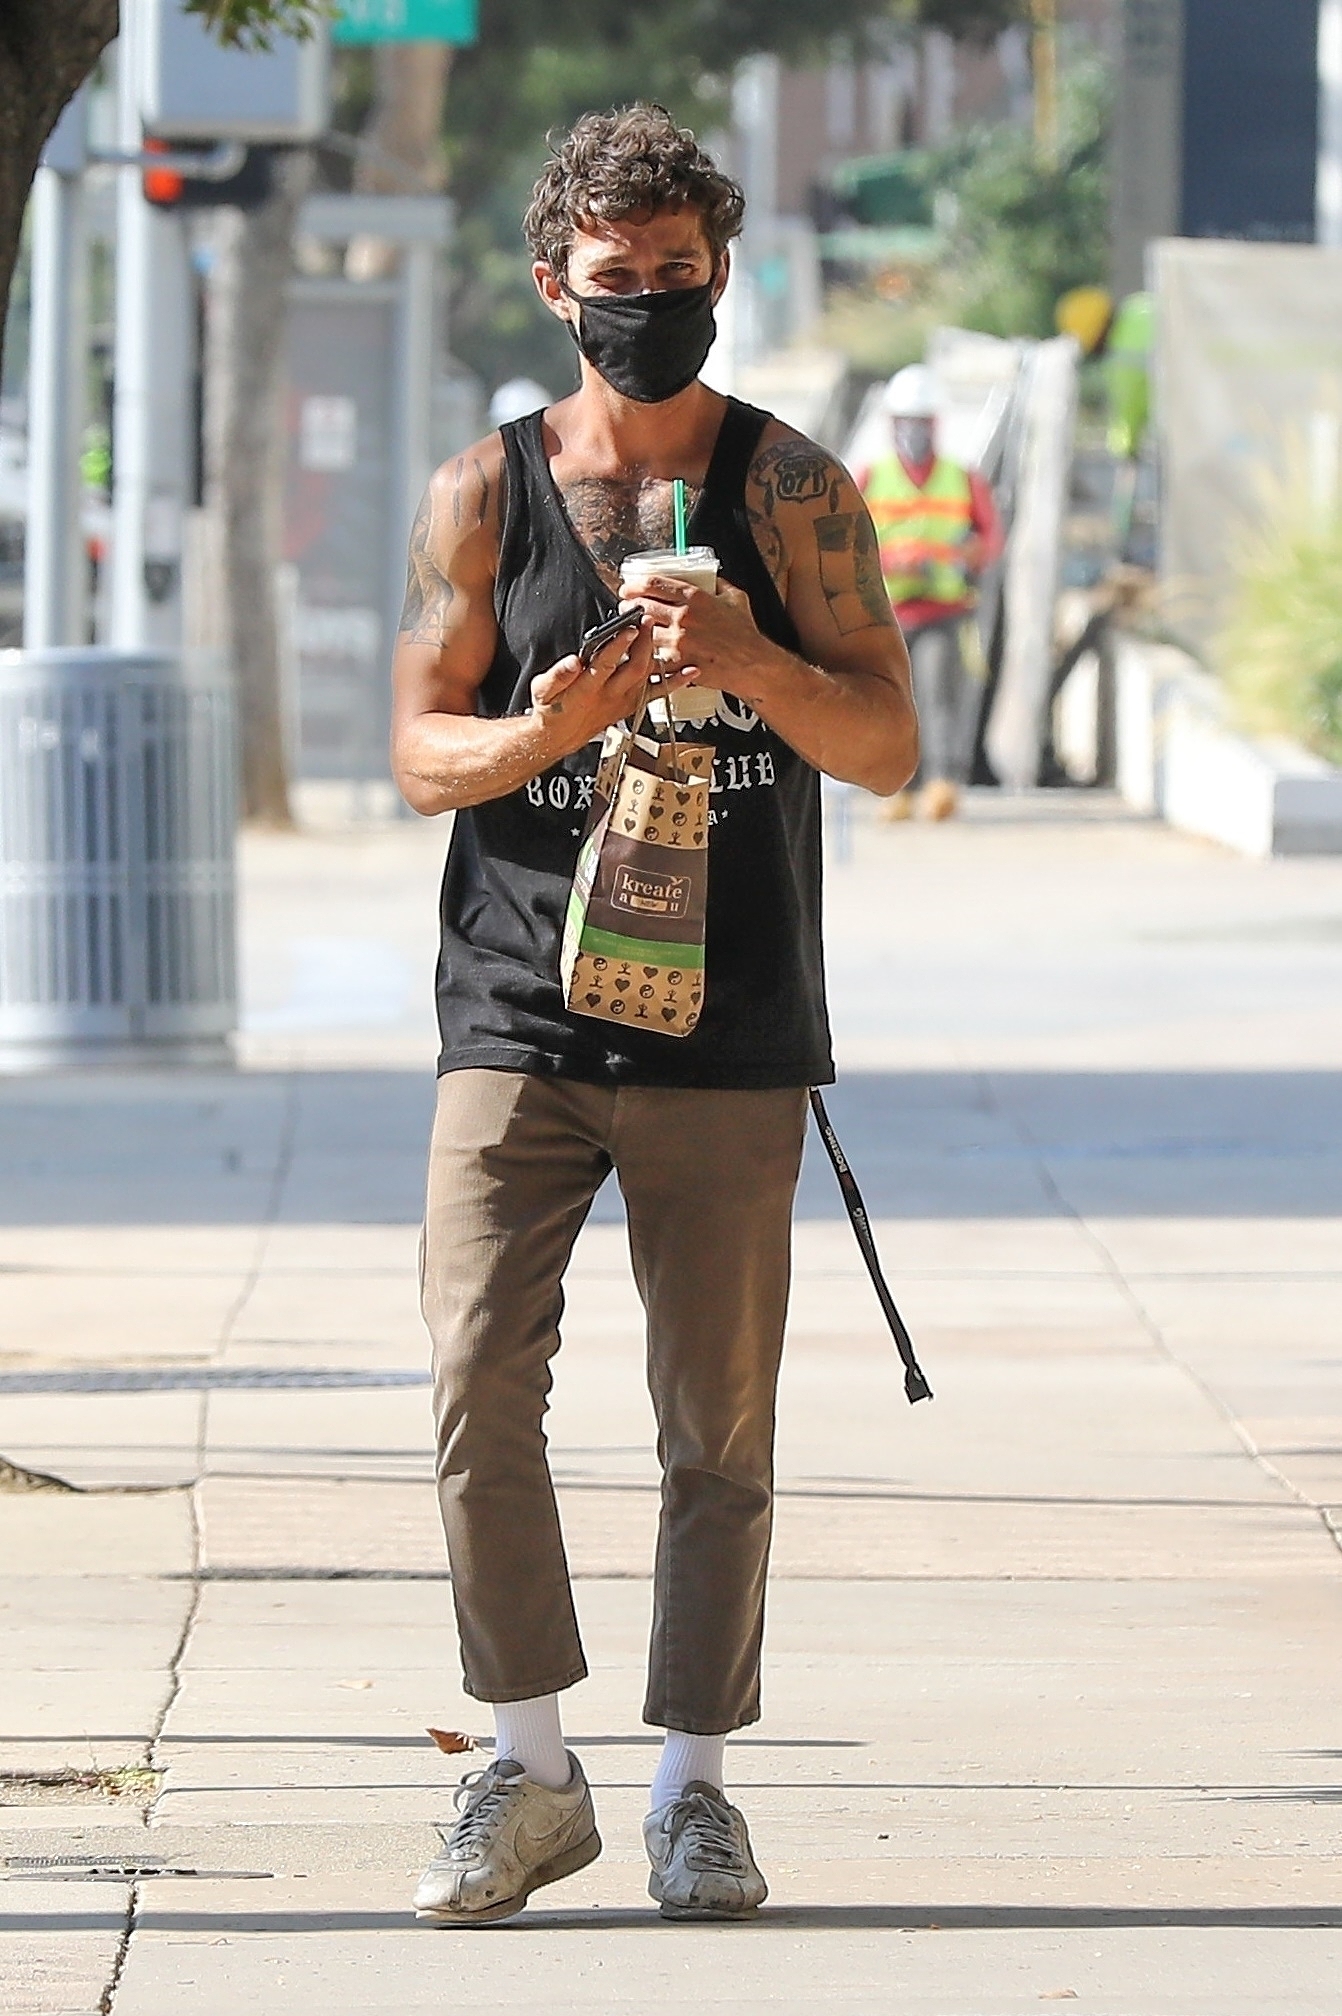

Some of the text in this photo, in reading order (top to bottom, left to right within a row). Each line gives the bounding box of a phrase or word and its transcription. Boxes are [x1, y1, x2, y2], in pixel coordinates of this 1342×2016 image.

[525, 751, 775, 811] BOX LUB
[619, 892, 628, 904] a
[670, 902, 679, 912] u
[621, 873, 683, 899] kreate
[824, 1125, 848, 1173] BOXING
